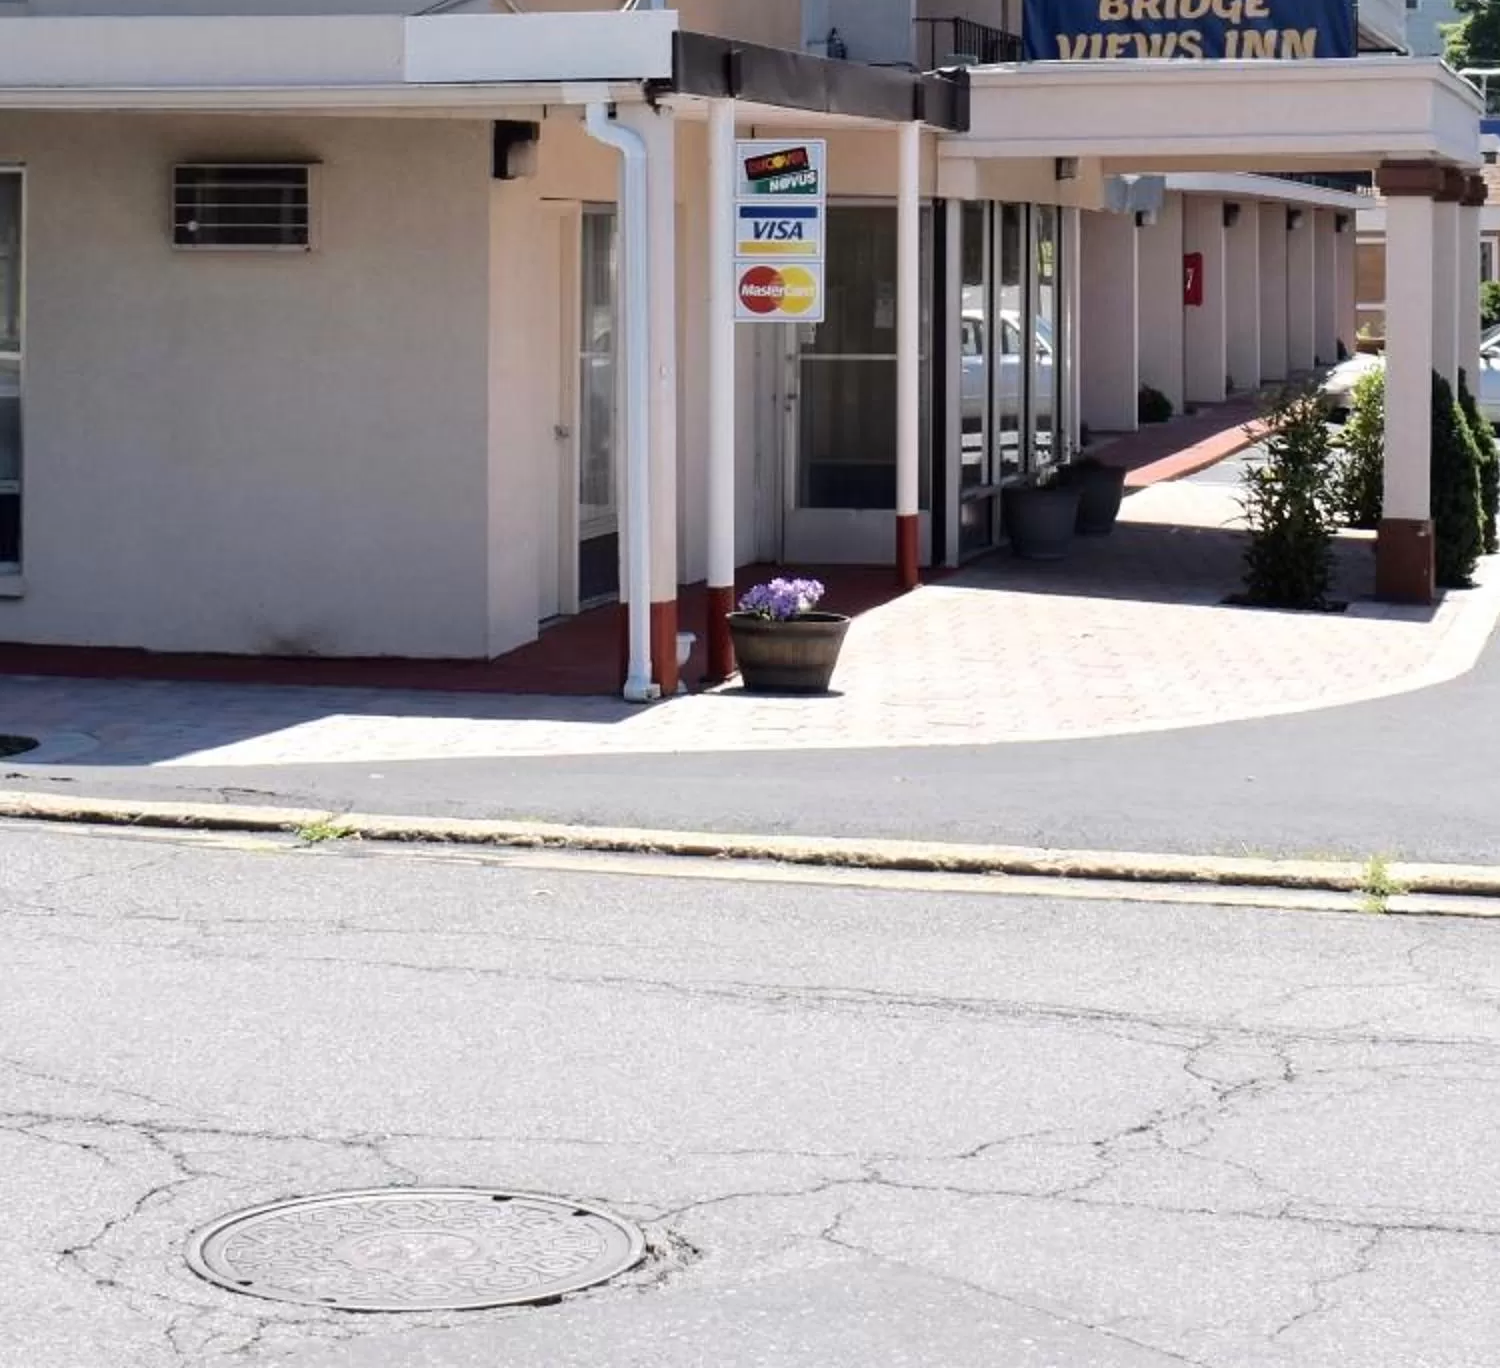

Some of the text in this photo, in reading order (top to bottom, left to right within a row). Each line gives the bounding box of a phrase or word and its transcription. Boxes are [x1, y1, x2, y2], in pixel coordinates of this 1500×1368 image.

[1055, 28, 1319, 60] VIEWS INN
[753, 221, 804, 240] VISA
